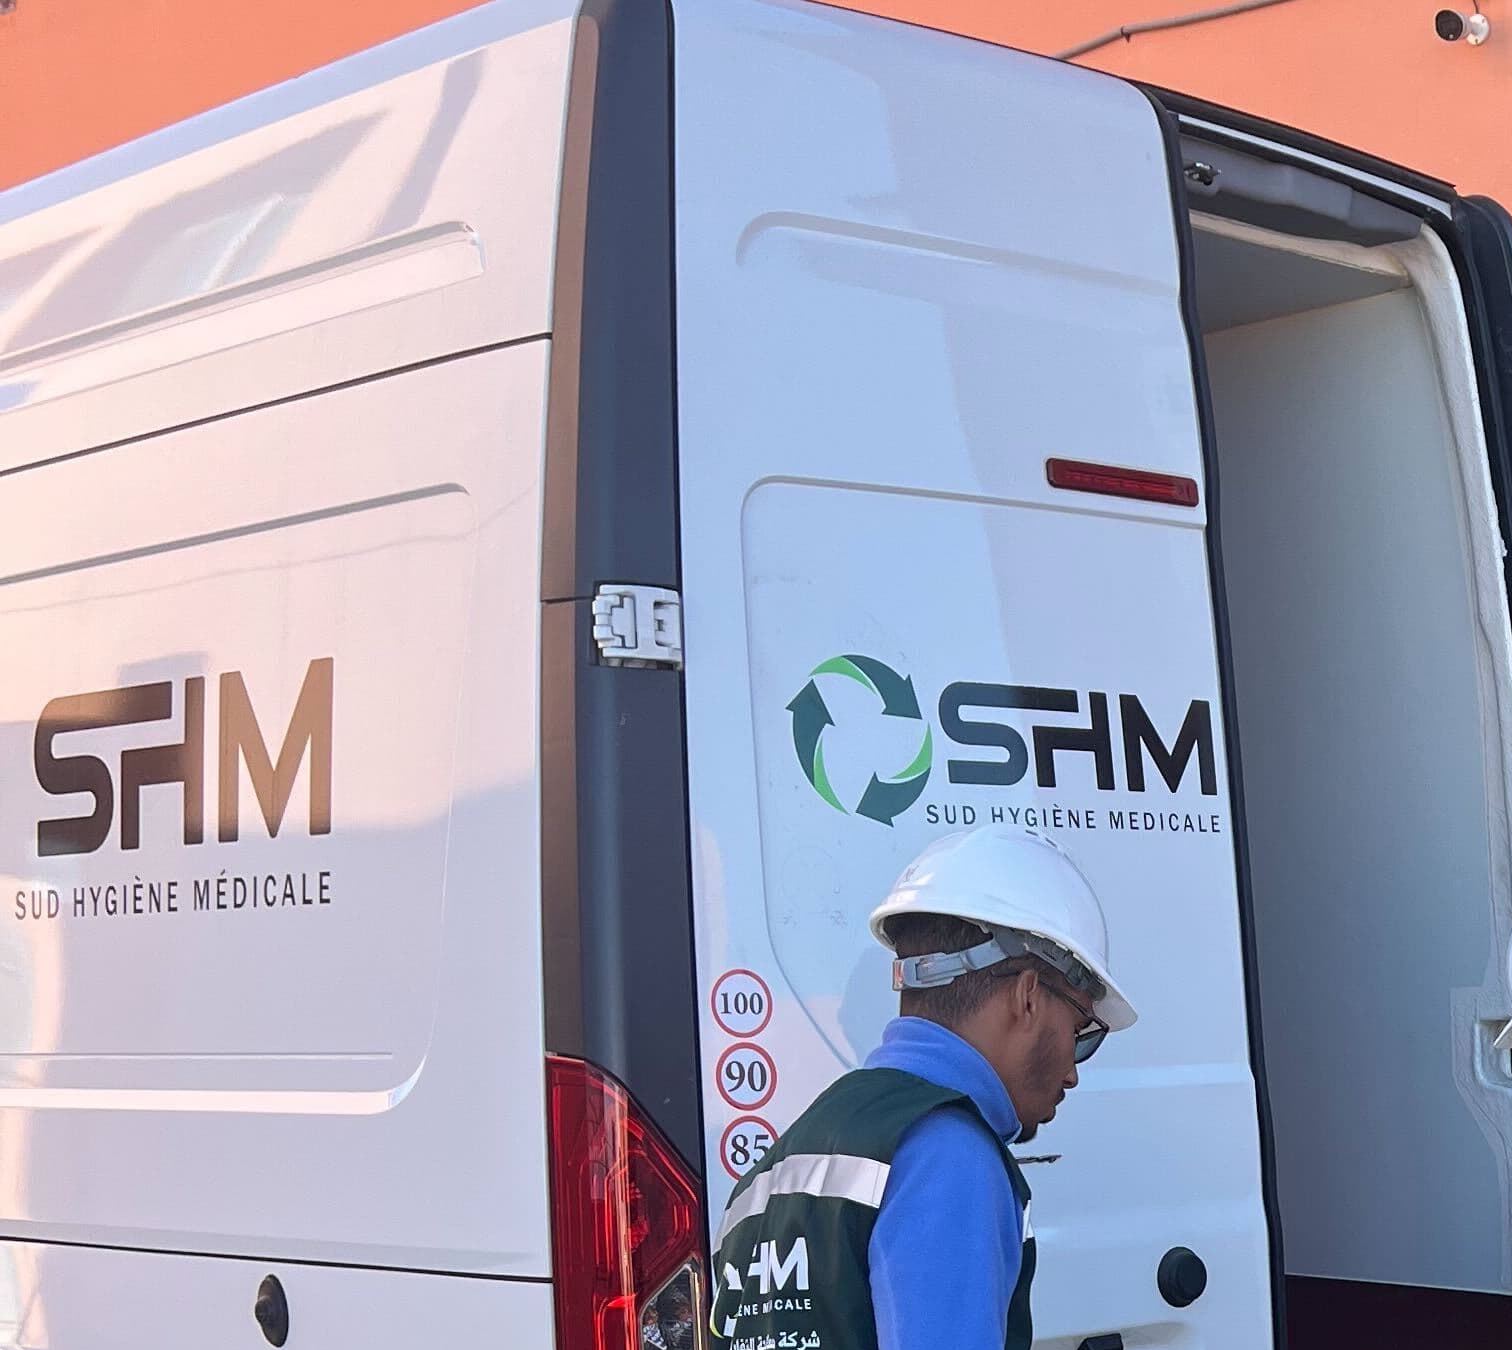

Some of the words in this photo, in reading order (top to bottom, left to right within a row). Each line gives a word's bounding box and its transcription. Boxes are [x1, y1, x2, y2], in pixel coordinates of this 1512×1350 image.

[33, 656, 334, 858] SHM
[937, 680, 1219, 796] SHM
[925, 804, 977, 826] SUD
[990, 802, 1098, 831] HYGIÈNE
[1108, 810, 1222, 834] MEDICALE
[14, 888, 60, 920] SUD
[72, 874, 179, 918] HYGIÈNE
[192, 868, 332, 911] MÉDICALE
[720, 991, 764, 1016] 100
[725, 1060, 768, 1093] 90
[730, 1134, 770, 1167] 85
[747, 1236, 809, 1294] HM
